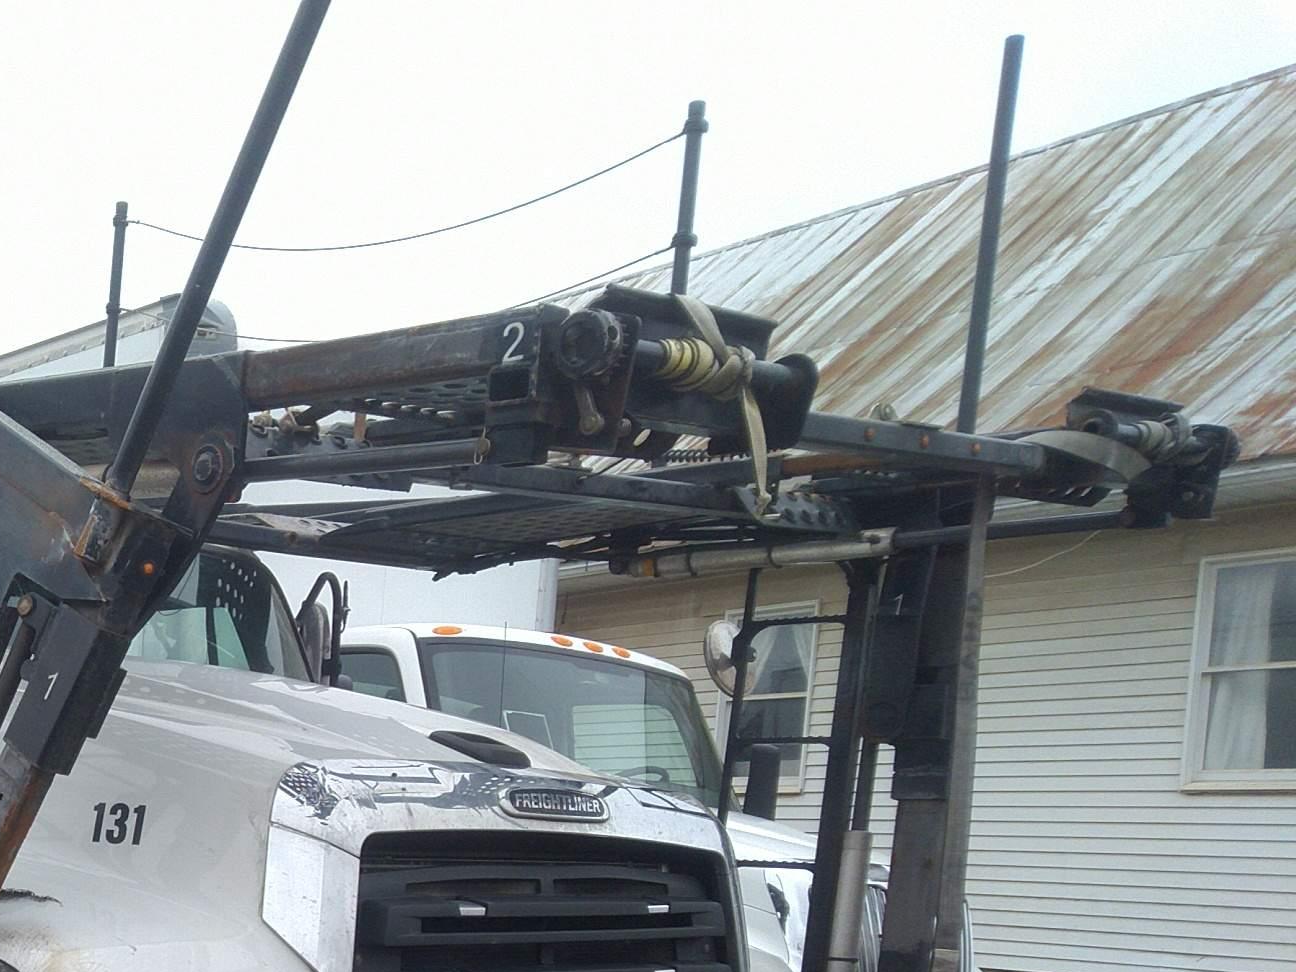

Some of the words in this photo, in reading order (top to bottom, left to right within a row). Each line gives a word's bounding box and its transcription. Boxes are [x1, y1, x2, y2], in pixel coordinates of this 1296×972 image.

[500, 321, 526, 363] 2
[894, 593, 904, 616] 1
[44, 672, 59, 700] 1
[514, 792, 602, 814] FREIGHTLINER
[92, 802, 147, 845] 131
